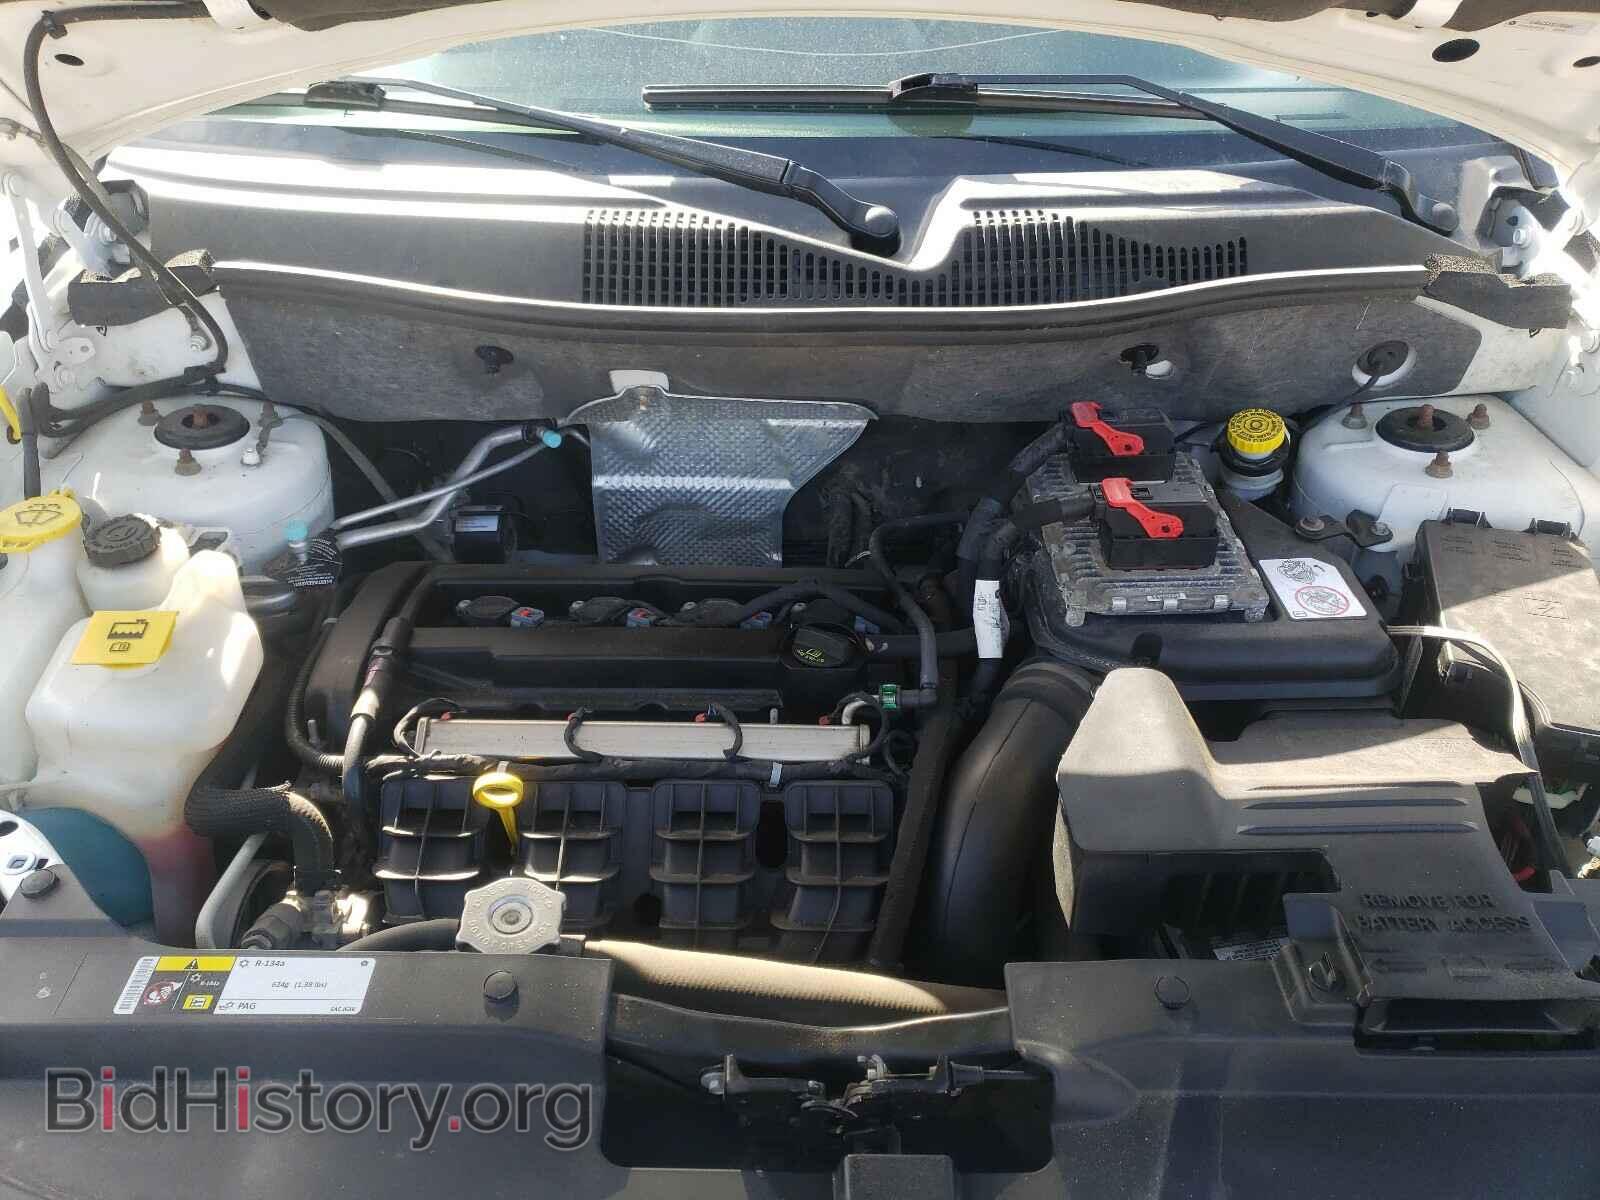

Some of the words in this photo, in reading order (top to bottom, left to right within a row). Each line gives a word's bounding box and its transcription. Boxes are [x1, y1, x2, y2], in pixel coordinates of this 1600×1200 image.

[1361, 893, 1447, 912] REMOVE
[1451, 894, 1496, 909] FOR
[1357, 914, 1440, 932] BATTERY
[1449, 915, 1533, 932] ACCESS
[254, 959, 286, 967] R-134a
[237, 1001, 257, 1010] PAG
